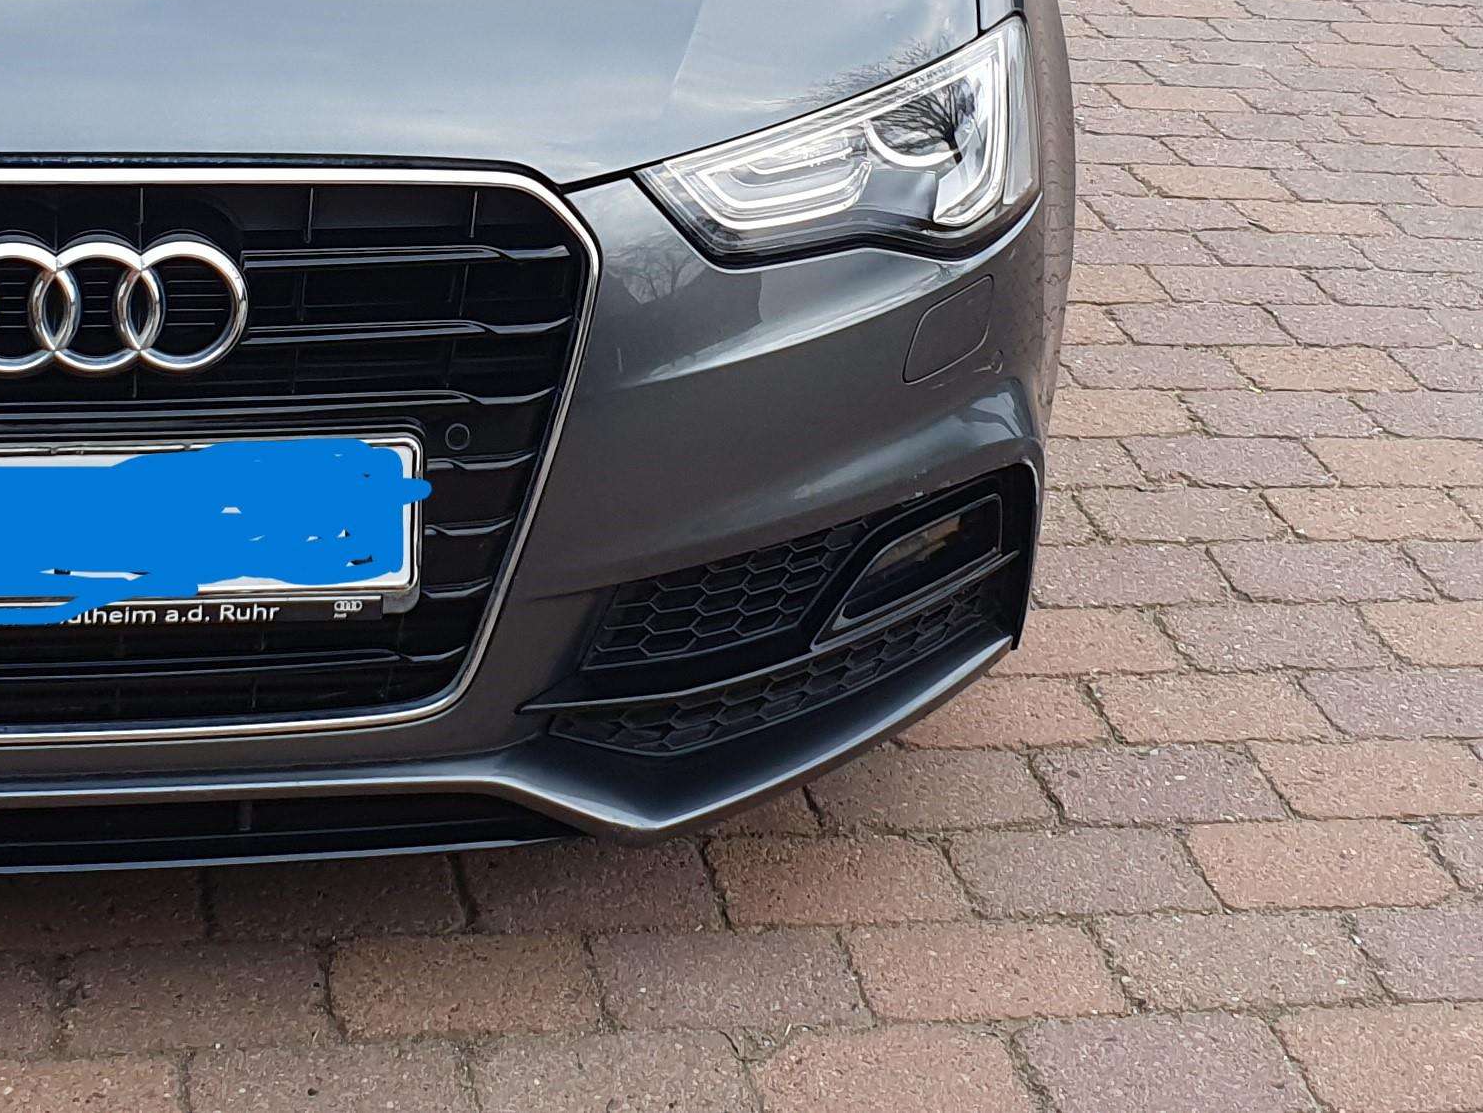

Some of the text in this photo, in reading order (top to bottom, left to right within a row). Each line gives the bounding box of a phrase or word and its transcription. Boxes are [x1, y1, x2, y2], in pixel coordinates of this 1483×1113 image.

[60, 603, 280, 625] lheim a.d. Ruhr
